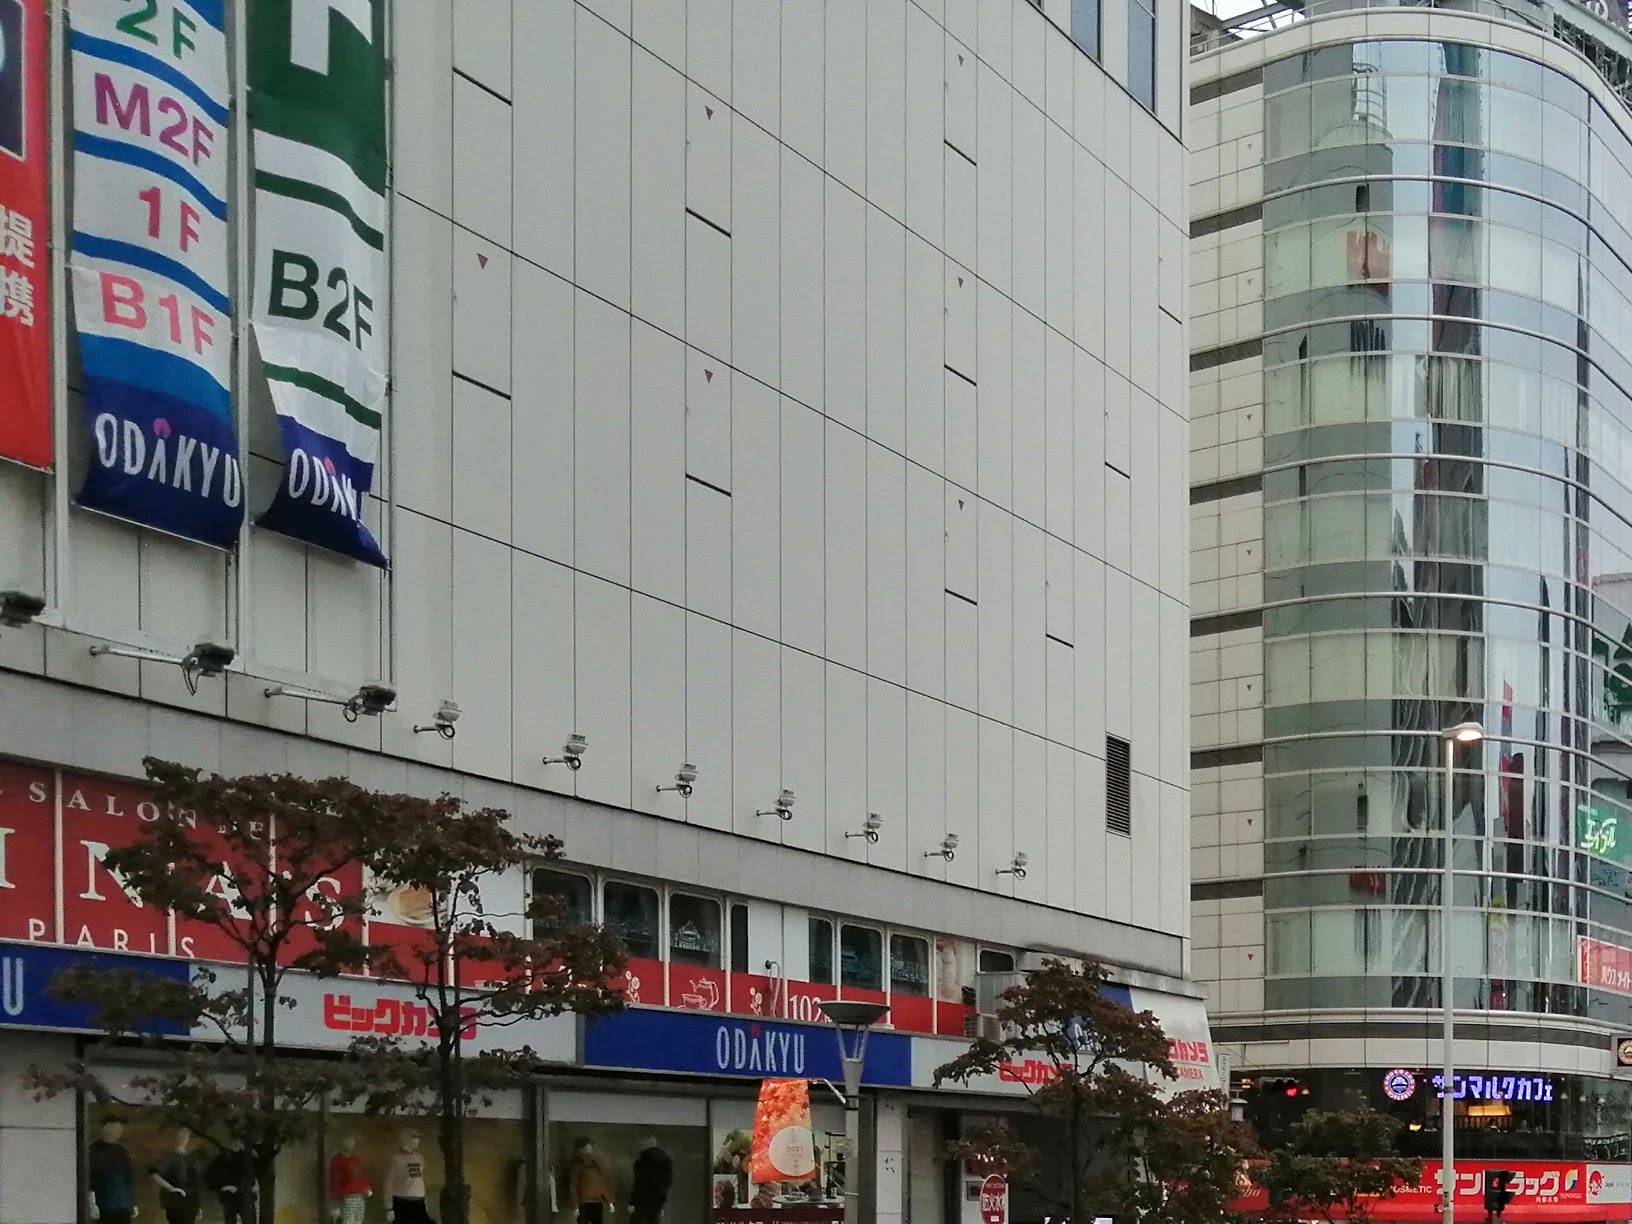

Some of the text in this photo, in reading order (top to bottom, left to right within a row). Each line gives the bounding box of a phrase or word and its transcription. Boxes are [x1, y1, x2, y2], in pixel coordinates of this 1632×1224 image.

[115, 0, 197, 58] 2F
[94, 73, 214, 166] M2F
[139, 186, 201, 253] 1F
[100, 272, 215, 356] B1F
[267, 248, 374, 351] B2F
[94, 413, 241, 508] ODAKYU
[29, 918, 195, 959] PARIS
[716, 1024, 805, 1075] ODAKYU
[1432, 1074, 1554, 1102] サンマルクカフェ
[1434, 1169, 1560, 1197] サンラッグ
